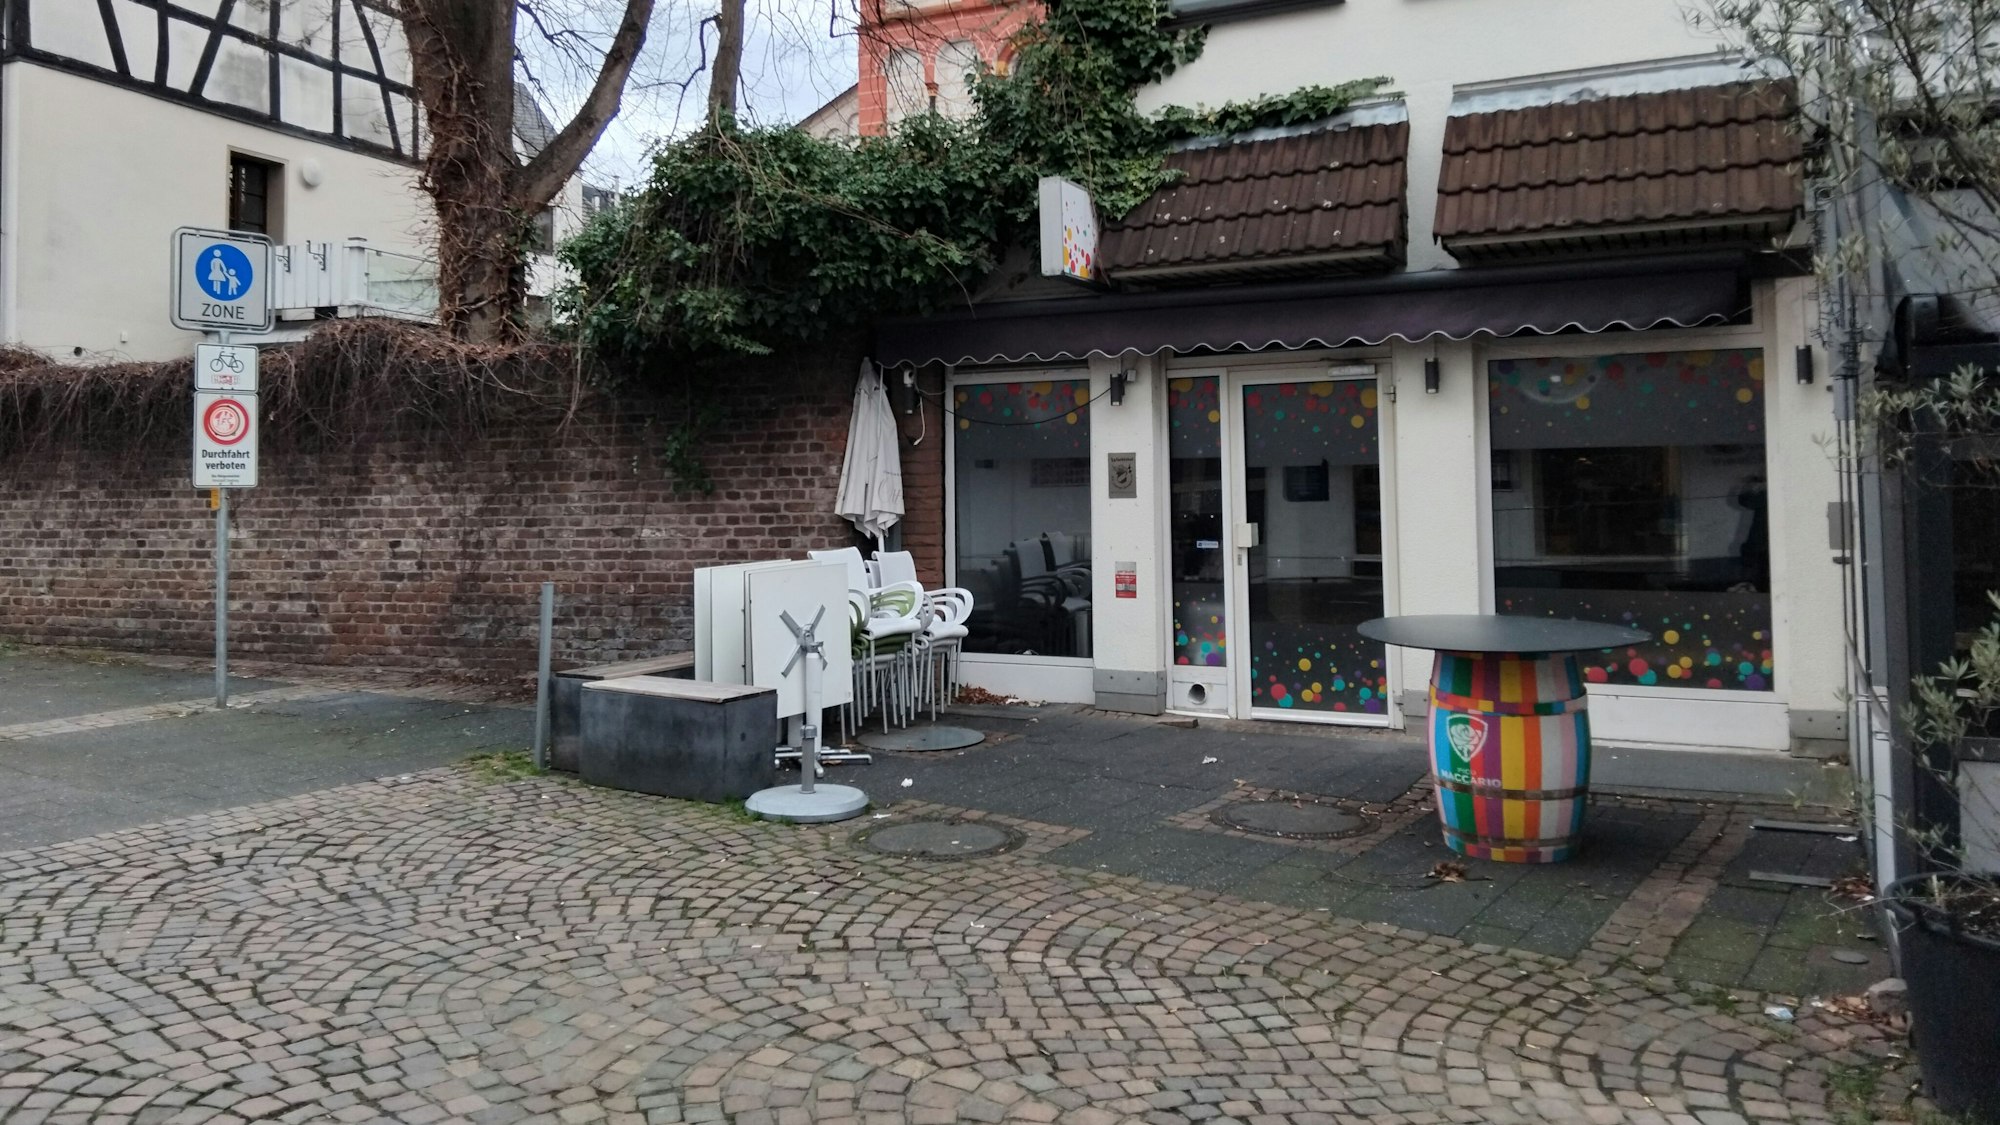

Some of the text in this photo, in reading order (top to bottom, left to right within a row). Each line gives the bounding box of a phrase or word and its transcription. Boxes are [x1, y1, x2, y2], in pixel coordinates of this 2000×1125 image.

[202, 303, 245, 320] ZONE
[201, 449, 250, 459] Durchfahrt
[205, 460, 246, 470] verboten
[1440, 769, 1501, 788] MACCARIO
